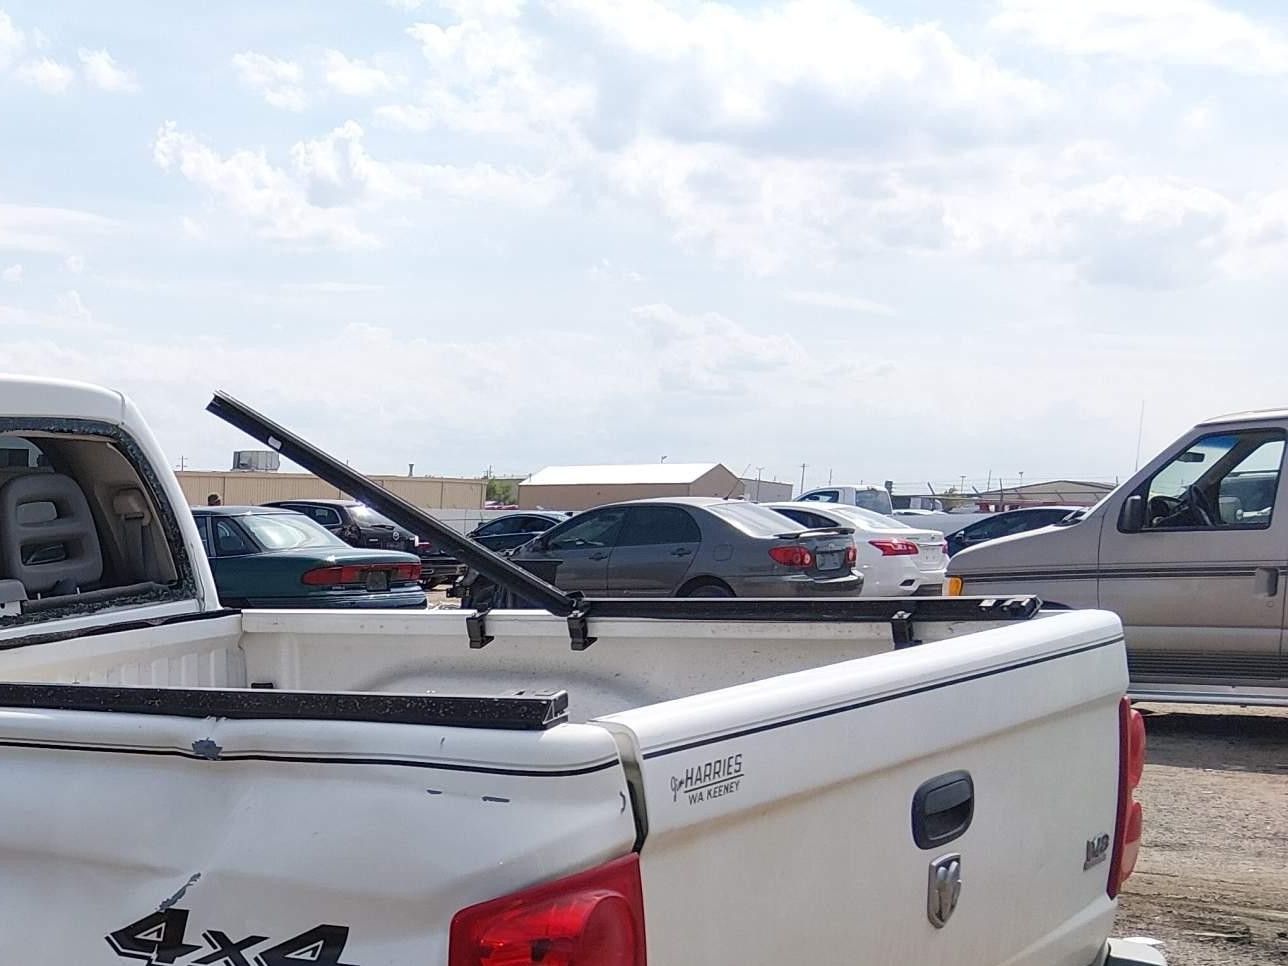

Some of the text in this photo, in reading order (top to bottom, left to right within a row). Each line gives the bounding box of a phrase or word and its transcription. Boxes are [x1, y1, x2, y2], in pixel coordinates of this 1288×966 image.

[683, 753, 743, 788] HARRIES
[688, 780, 741, 806] WA KEENEY
